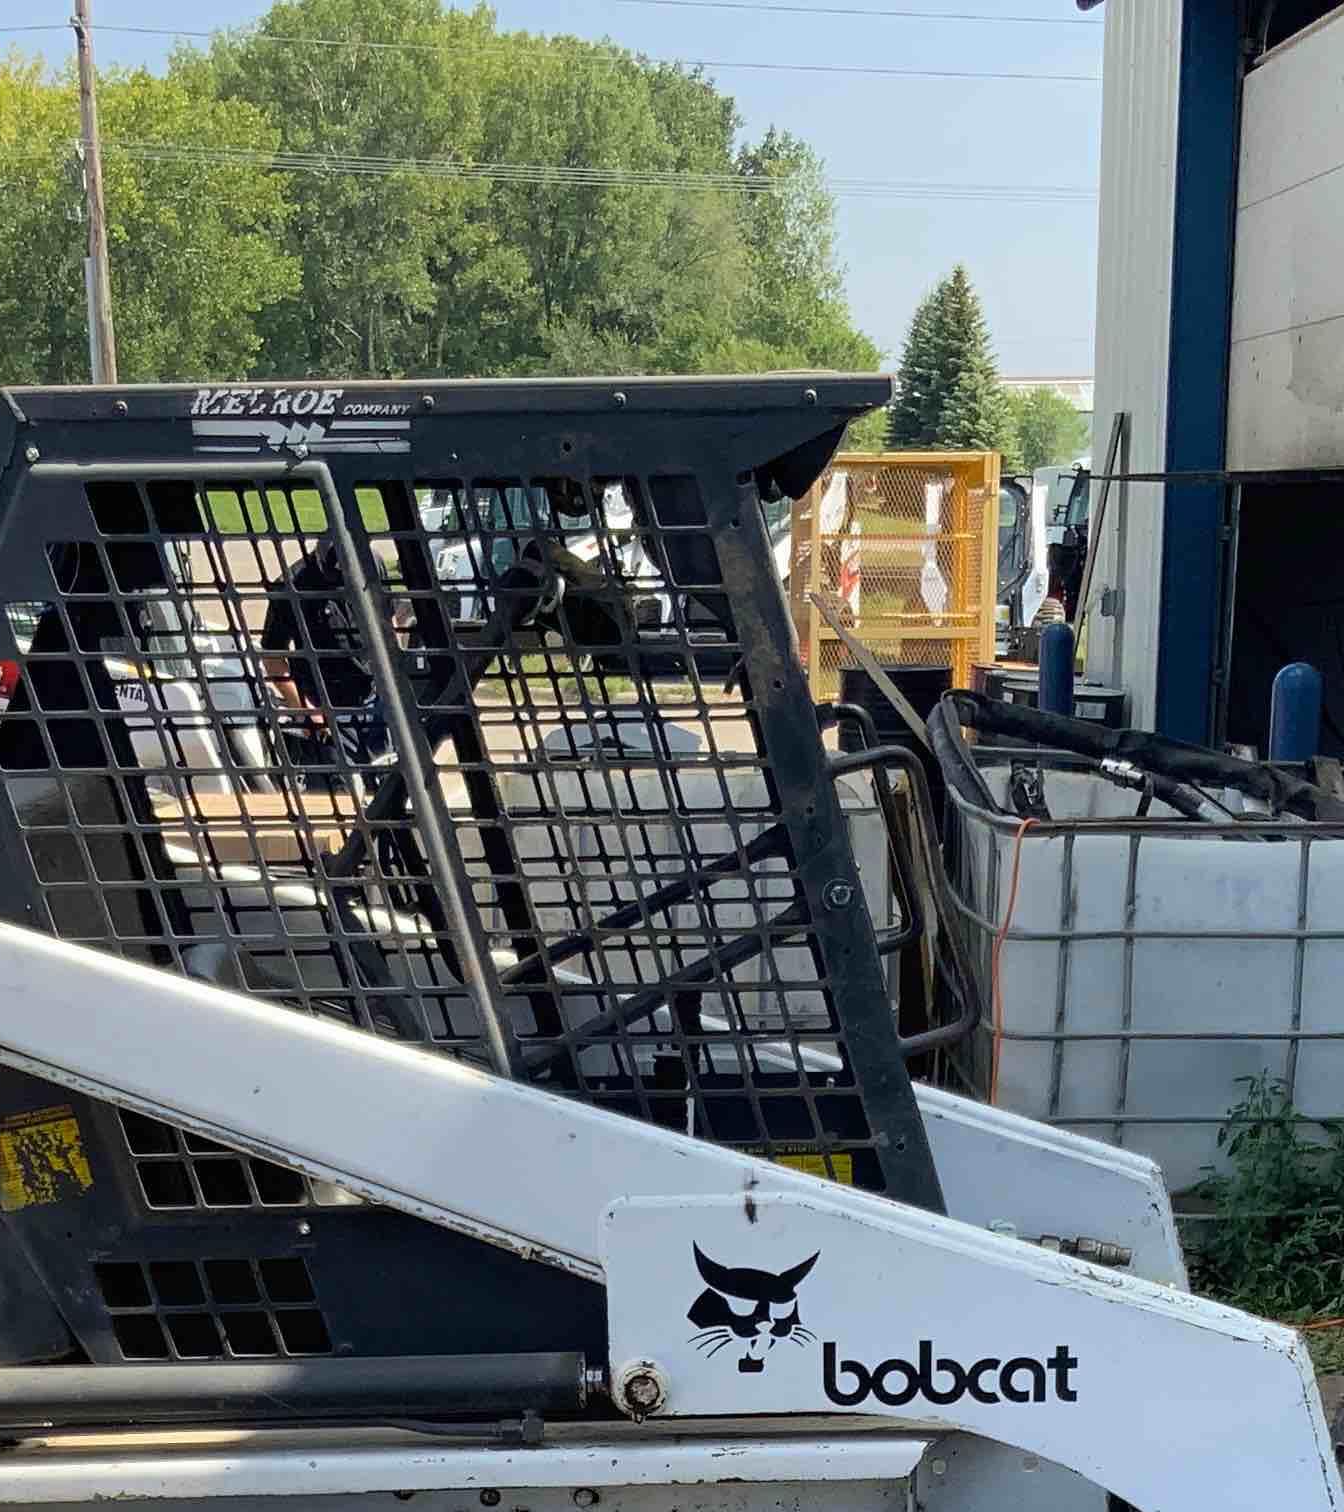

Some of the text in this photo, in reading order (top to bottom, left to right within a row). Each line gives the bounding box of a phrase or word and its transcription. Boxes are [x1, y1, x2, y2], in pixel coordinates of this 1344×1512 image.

[191, 389, 410, 416] MELROE COMPANY
[823, 1340, 1078, 1407] bobcat
